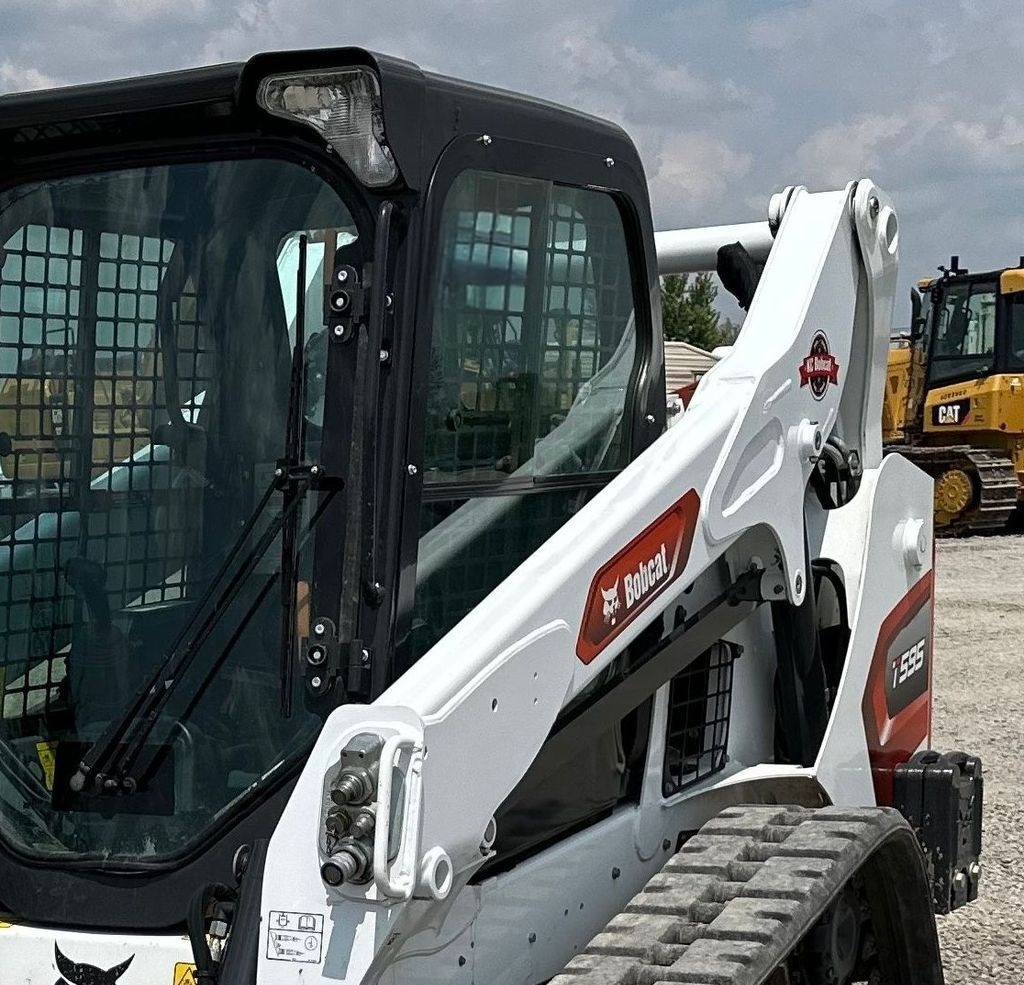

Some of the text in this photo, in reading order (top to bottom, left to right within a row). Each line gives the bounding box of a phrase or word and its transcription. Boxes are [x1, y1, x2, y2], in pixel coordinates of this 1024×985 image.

[938, 404, 961, 424] CAT
[623, 542, 668, 610] Bobcat
[891, 638, 926, 689] T595
